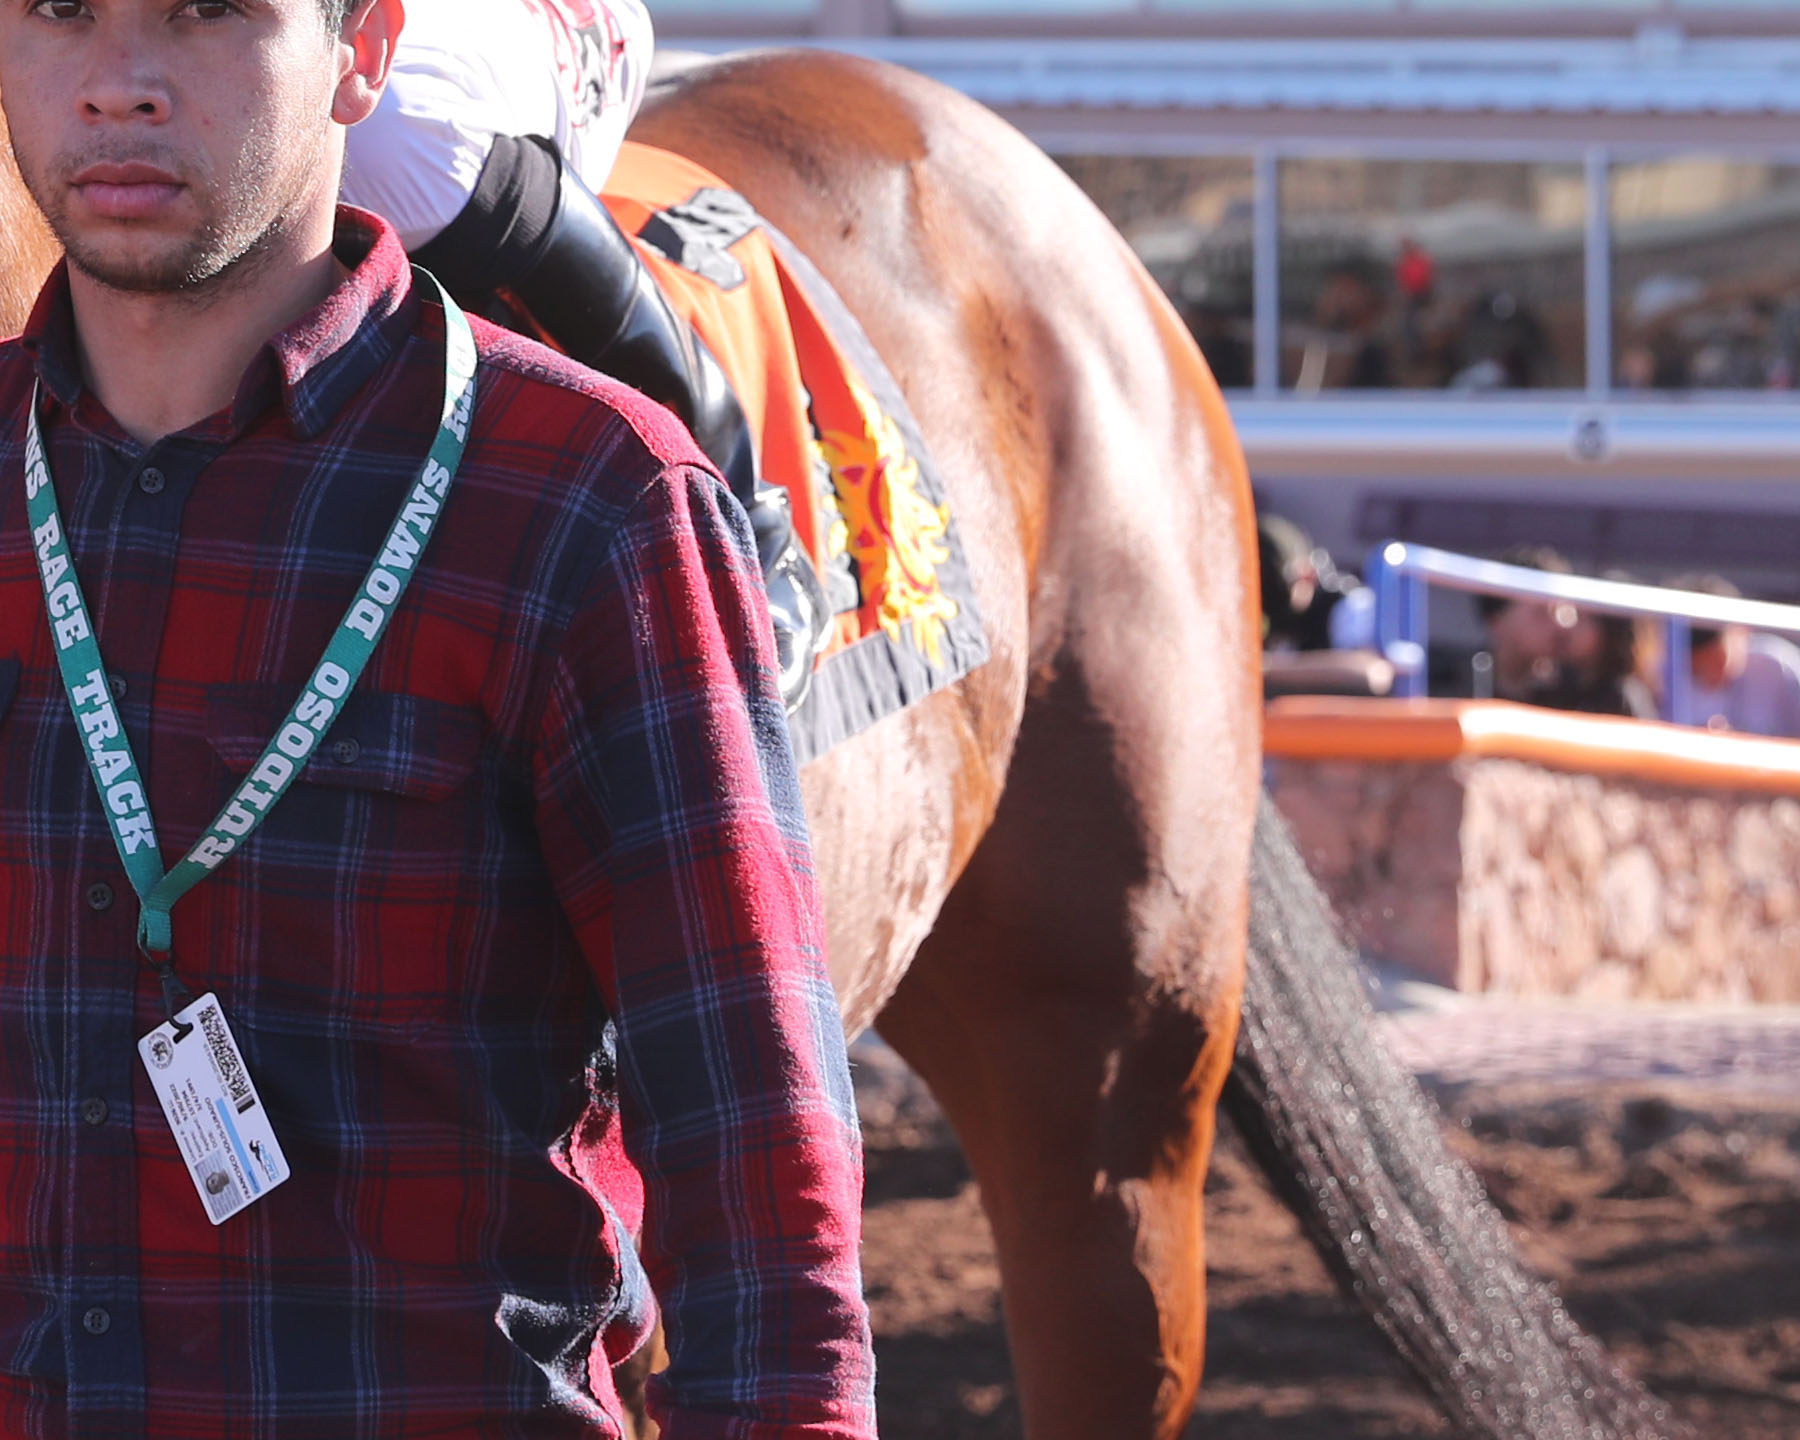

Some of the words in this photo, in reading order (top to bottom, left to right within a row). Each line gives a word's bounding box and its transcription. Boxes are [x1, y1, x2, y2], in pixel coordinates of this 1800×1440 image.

[34, 512, 90, 651] RACE
[71, 668, 157, 856] TRACK
[189, 661, 350, 870] RUIDOSO
[345, 459, 450, 641] DOWNS
